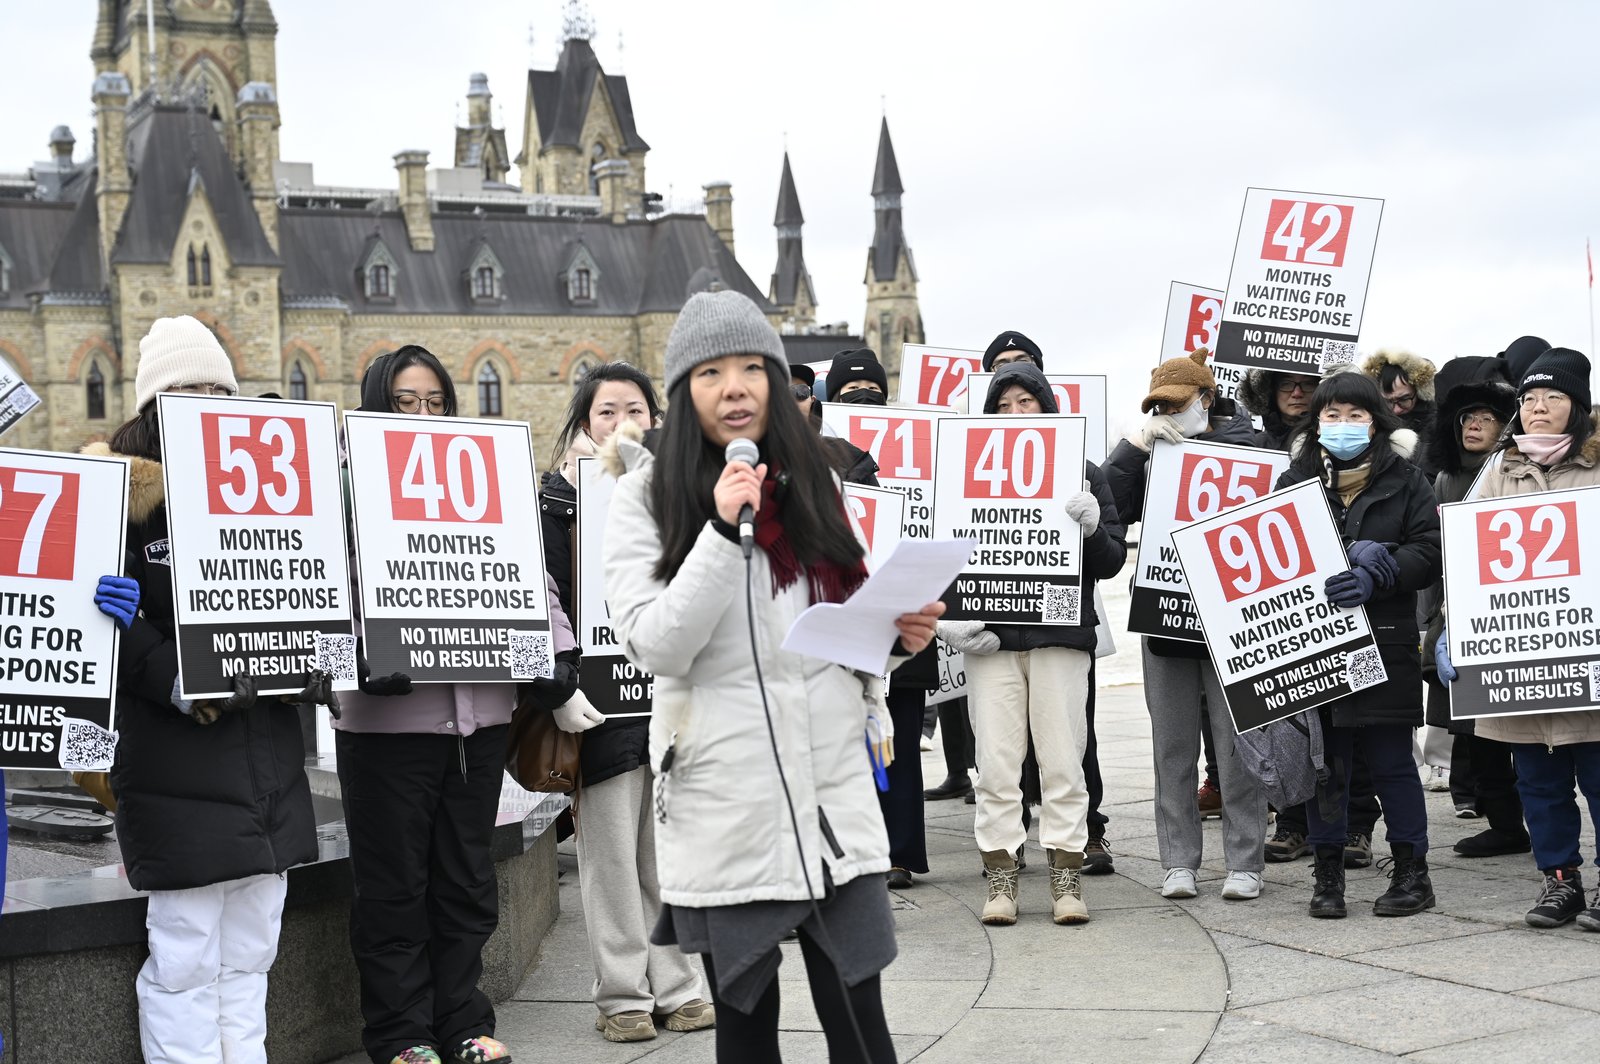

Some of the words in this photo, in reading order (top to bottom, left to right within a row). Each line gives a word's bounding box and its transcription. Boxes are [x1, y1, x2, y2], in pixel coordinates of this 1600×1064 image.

[1272, 202, 1342, 264] 42
[1266, 268, 1332, 287] MONTHS
[1247, 284, 1311, 304] WAITING
[1315, 292, 1346, 308] FOR
[1233, 302, 1267, 317] IRCC
[1269, 306, 1352, 327] RESPONSE
[1192, 299, 1222, 356] 3
[1243, 330, 1261, 342] NO
[1264, 332, 1329, 349] TIMELINE
[1246, 345, 1264, 358] NO
[1267, 348, 1322, 364] RESULTS
[928, 357, 972, 406] 72
[860, 418, 921, 478] 71
[218, 417, 300, 514] 53
[974, 429, 1045, 498] 40
[401, 434, 488, 521] 40
[1188, 458, 1260, 522] 65
[0, 471, 63, 575] 7
[911, 506, 932, 520] FO
[971, 508, 1042, 525] MONTHS
[220, 529, 302, 550] MONTHS
[408, 534, 495, 555] MONTHS
[953, 529, 1022, 545] WAITING
[1028, 530, 1060, 545] FOR
[1488, 504, 1569, 582] 32
[981, 550, 1070, 566] RESPONSE
[1218, 510, 1300, 594] 90
[199, 559, 283, 580] WAITING
[289, 559, 326, 580] FOR
[386, 560, 474, 581] WAITING
[481, 563, 520, 582] FOR
[1146, 565, 1182, 584] IRCC
[957, 580, 976, 593] NO
[190, 589, 234, 611] IRCC
[237, 588, 339, 610] RESPONSE
[376, 588, 422, 607] IRCC
[427, 588, 534, 609] RESPONSE
[962, 598, 981, 611] NO
[985, 598, 1043, 612] RESULTS
[1159, 597, 1178, 610] NO
[1241, 585, 1314, 623] MONTHS
[1490, 587, 1570, 610] MONTHS
[1163, 614, 1181, 628] NO
[1229, 612, 1303, 650] WAITING
[1305, 601, 1341, 623] FOR
[1471, 611, 1550, 634] WAITING
[1556, 607, 1593, 626] FOR
[31, 627, 82, 652] FOR
[213, 634, 236, 652] NO
[401, 628, 425, 644] NO
[1227, 648, 1266, 674] IRCC
[1266, 615, 1357, 660] RESPONSE
[410, 650, 434, 667] NO
[440, 651, 511, 667] RESULTS
[1461, 638, 1501, 657] IRCC
[222, 658, 245, 677] NO
[249, 655, 316, 676] RESULTS
[613, 663, 635, 680] NO
[1253, 678, 1274, 696] NO
[1275, 651, 1348, 688] TIMELINES
[1481, 670, 1502, 685] NO
[1506, 662, 1589, 683] TIMELINES
[620, 684, 642, 700] NO
[1265, 693, 1286, 710] NO
[1288, 670, 1348, 702] RESULTS
[1489, 688, 1510, 703] NO
[1515, 682, 1583, 701] RESULTS
